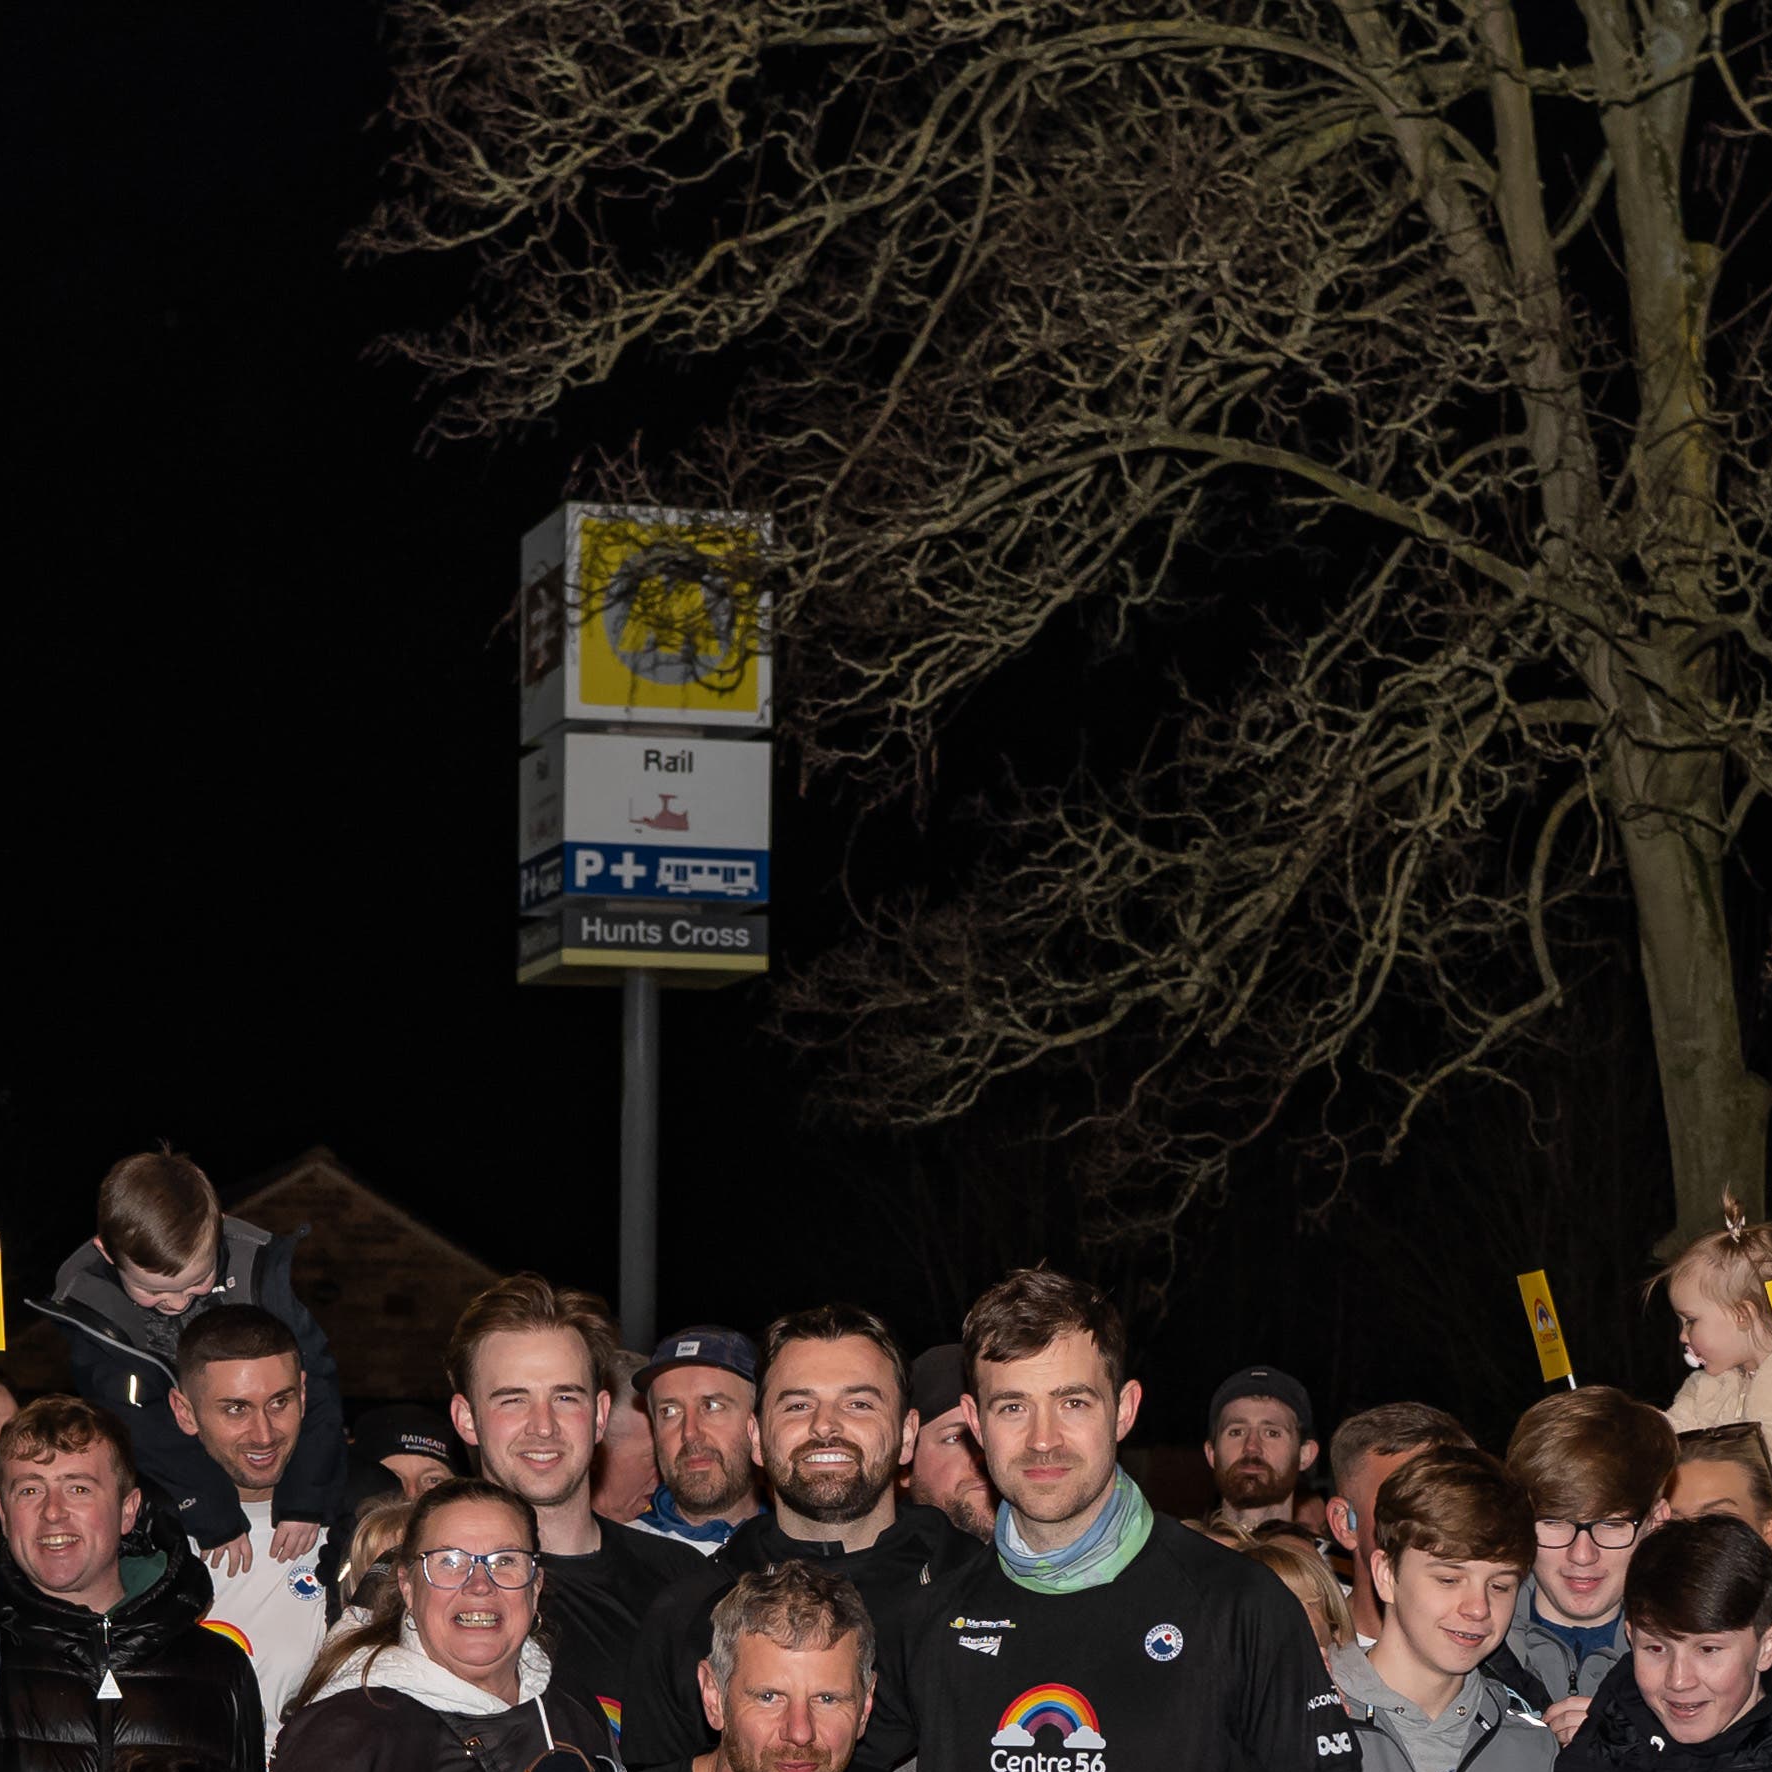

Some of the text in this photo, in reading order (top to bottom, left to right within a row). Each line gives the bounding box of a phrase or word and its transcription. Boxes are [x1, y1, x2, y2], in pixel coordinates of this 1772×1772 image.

[644, 749, 694, 774] Rail
[582, 917, 750, 948] Hunts Cross
